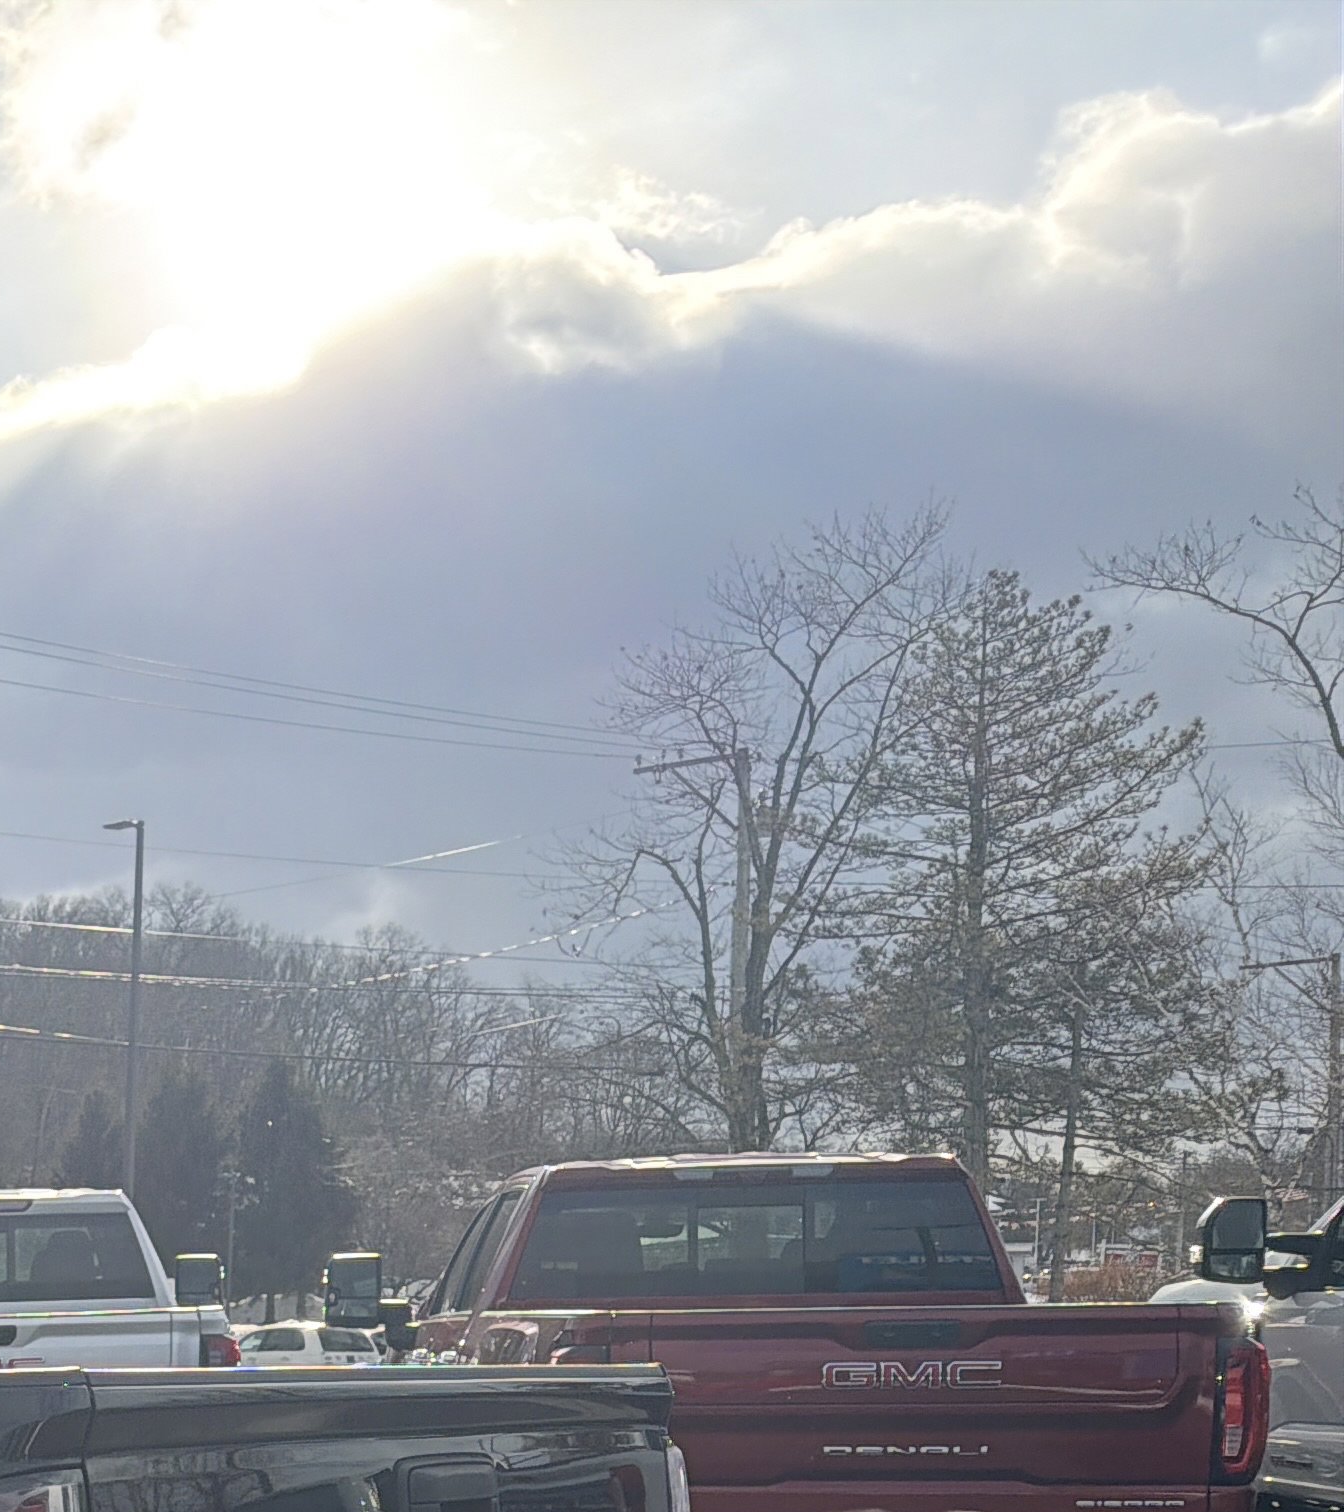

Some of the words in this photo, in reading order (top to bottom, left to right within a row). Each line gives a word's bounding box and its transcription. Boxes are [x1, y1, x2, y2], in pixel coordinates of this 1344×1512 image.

[822, 1361, 1002, 1390] GMC
[823, 1445, 989, 1456] DENALI
[1075, 1500, 1185, 1508] SIERRA
